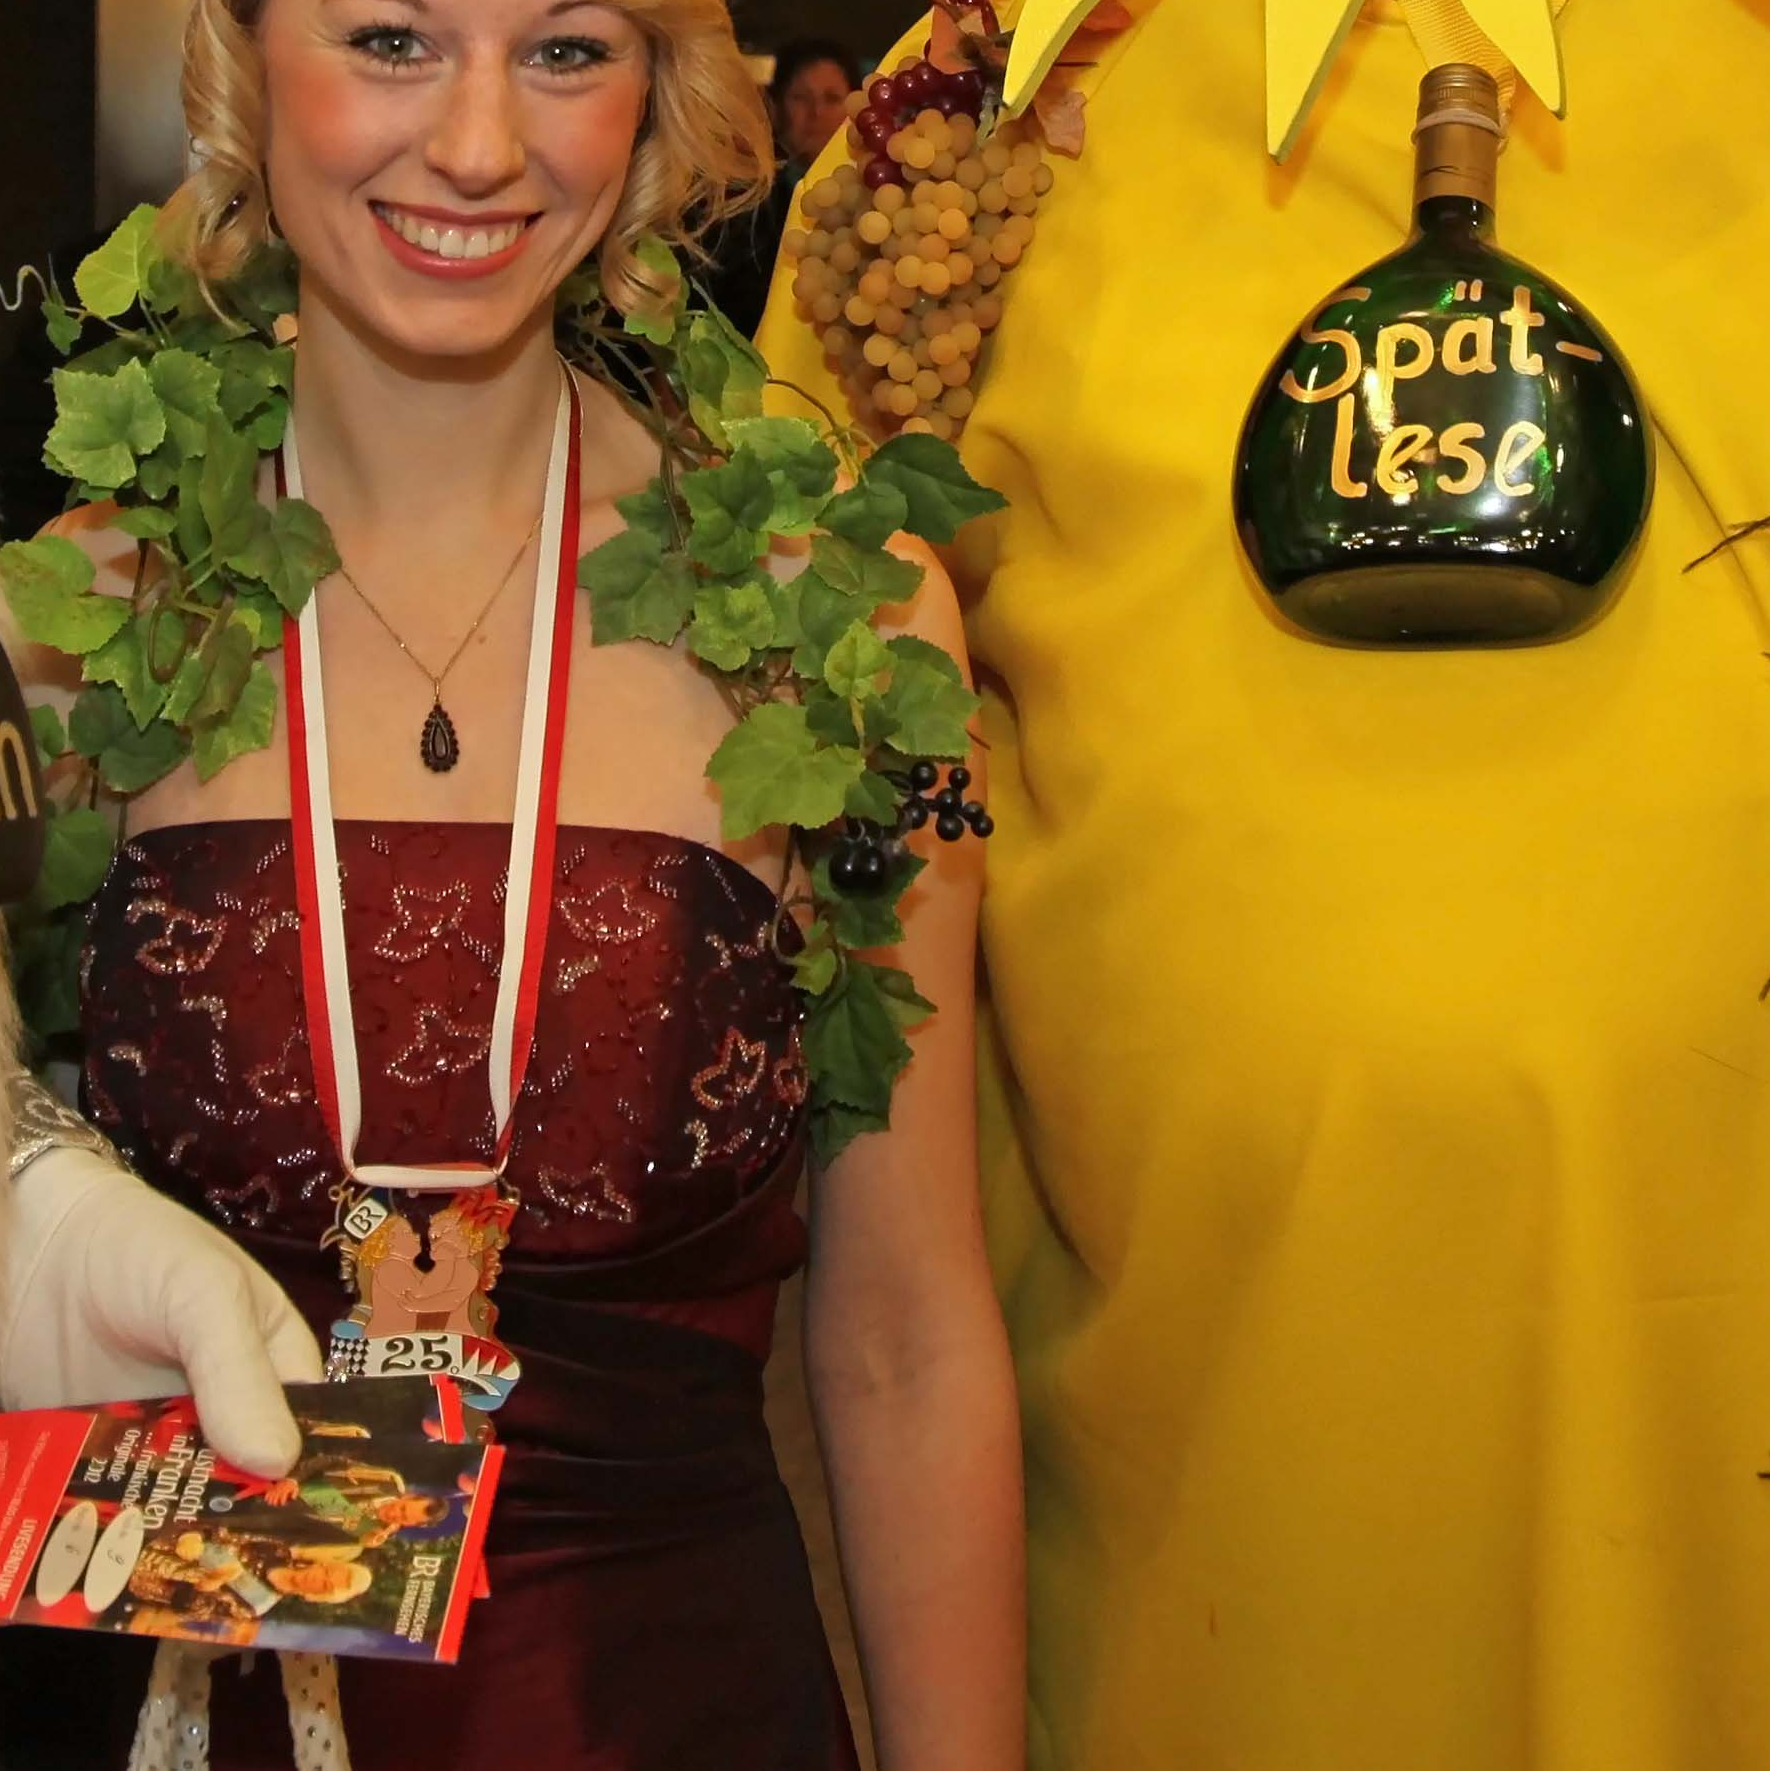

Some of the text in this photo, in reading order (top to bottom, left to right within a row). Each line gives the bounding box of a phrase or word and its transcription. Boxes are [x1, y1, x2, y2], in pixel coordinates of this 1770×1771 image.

[349, 1204, 383, 1235] BR
[173, 1448, 215, 1524] astnacht
[410, 1556, 441, 1578] BR
